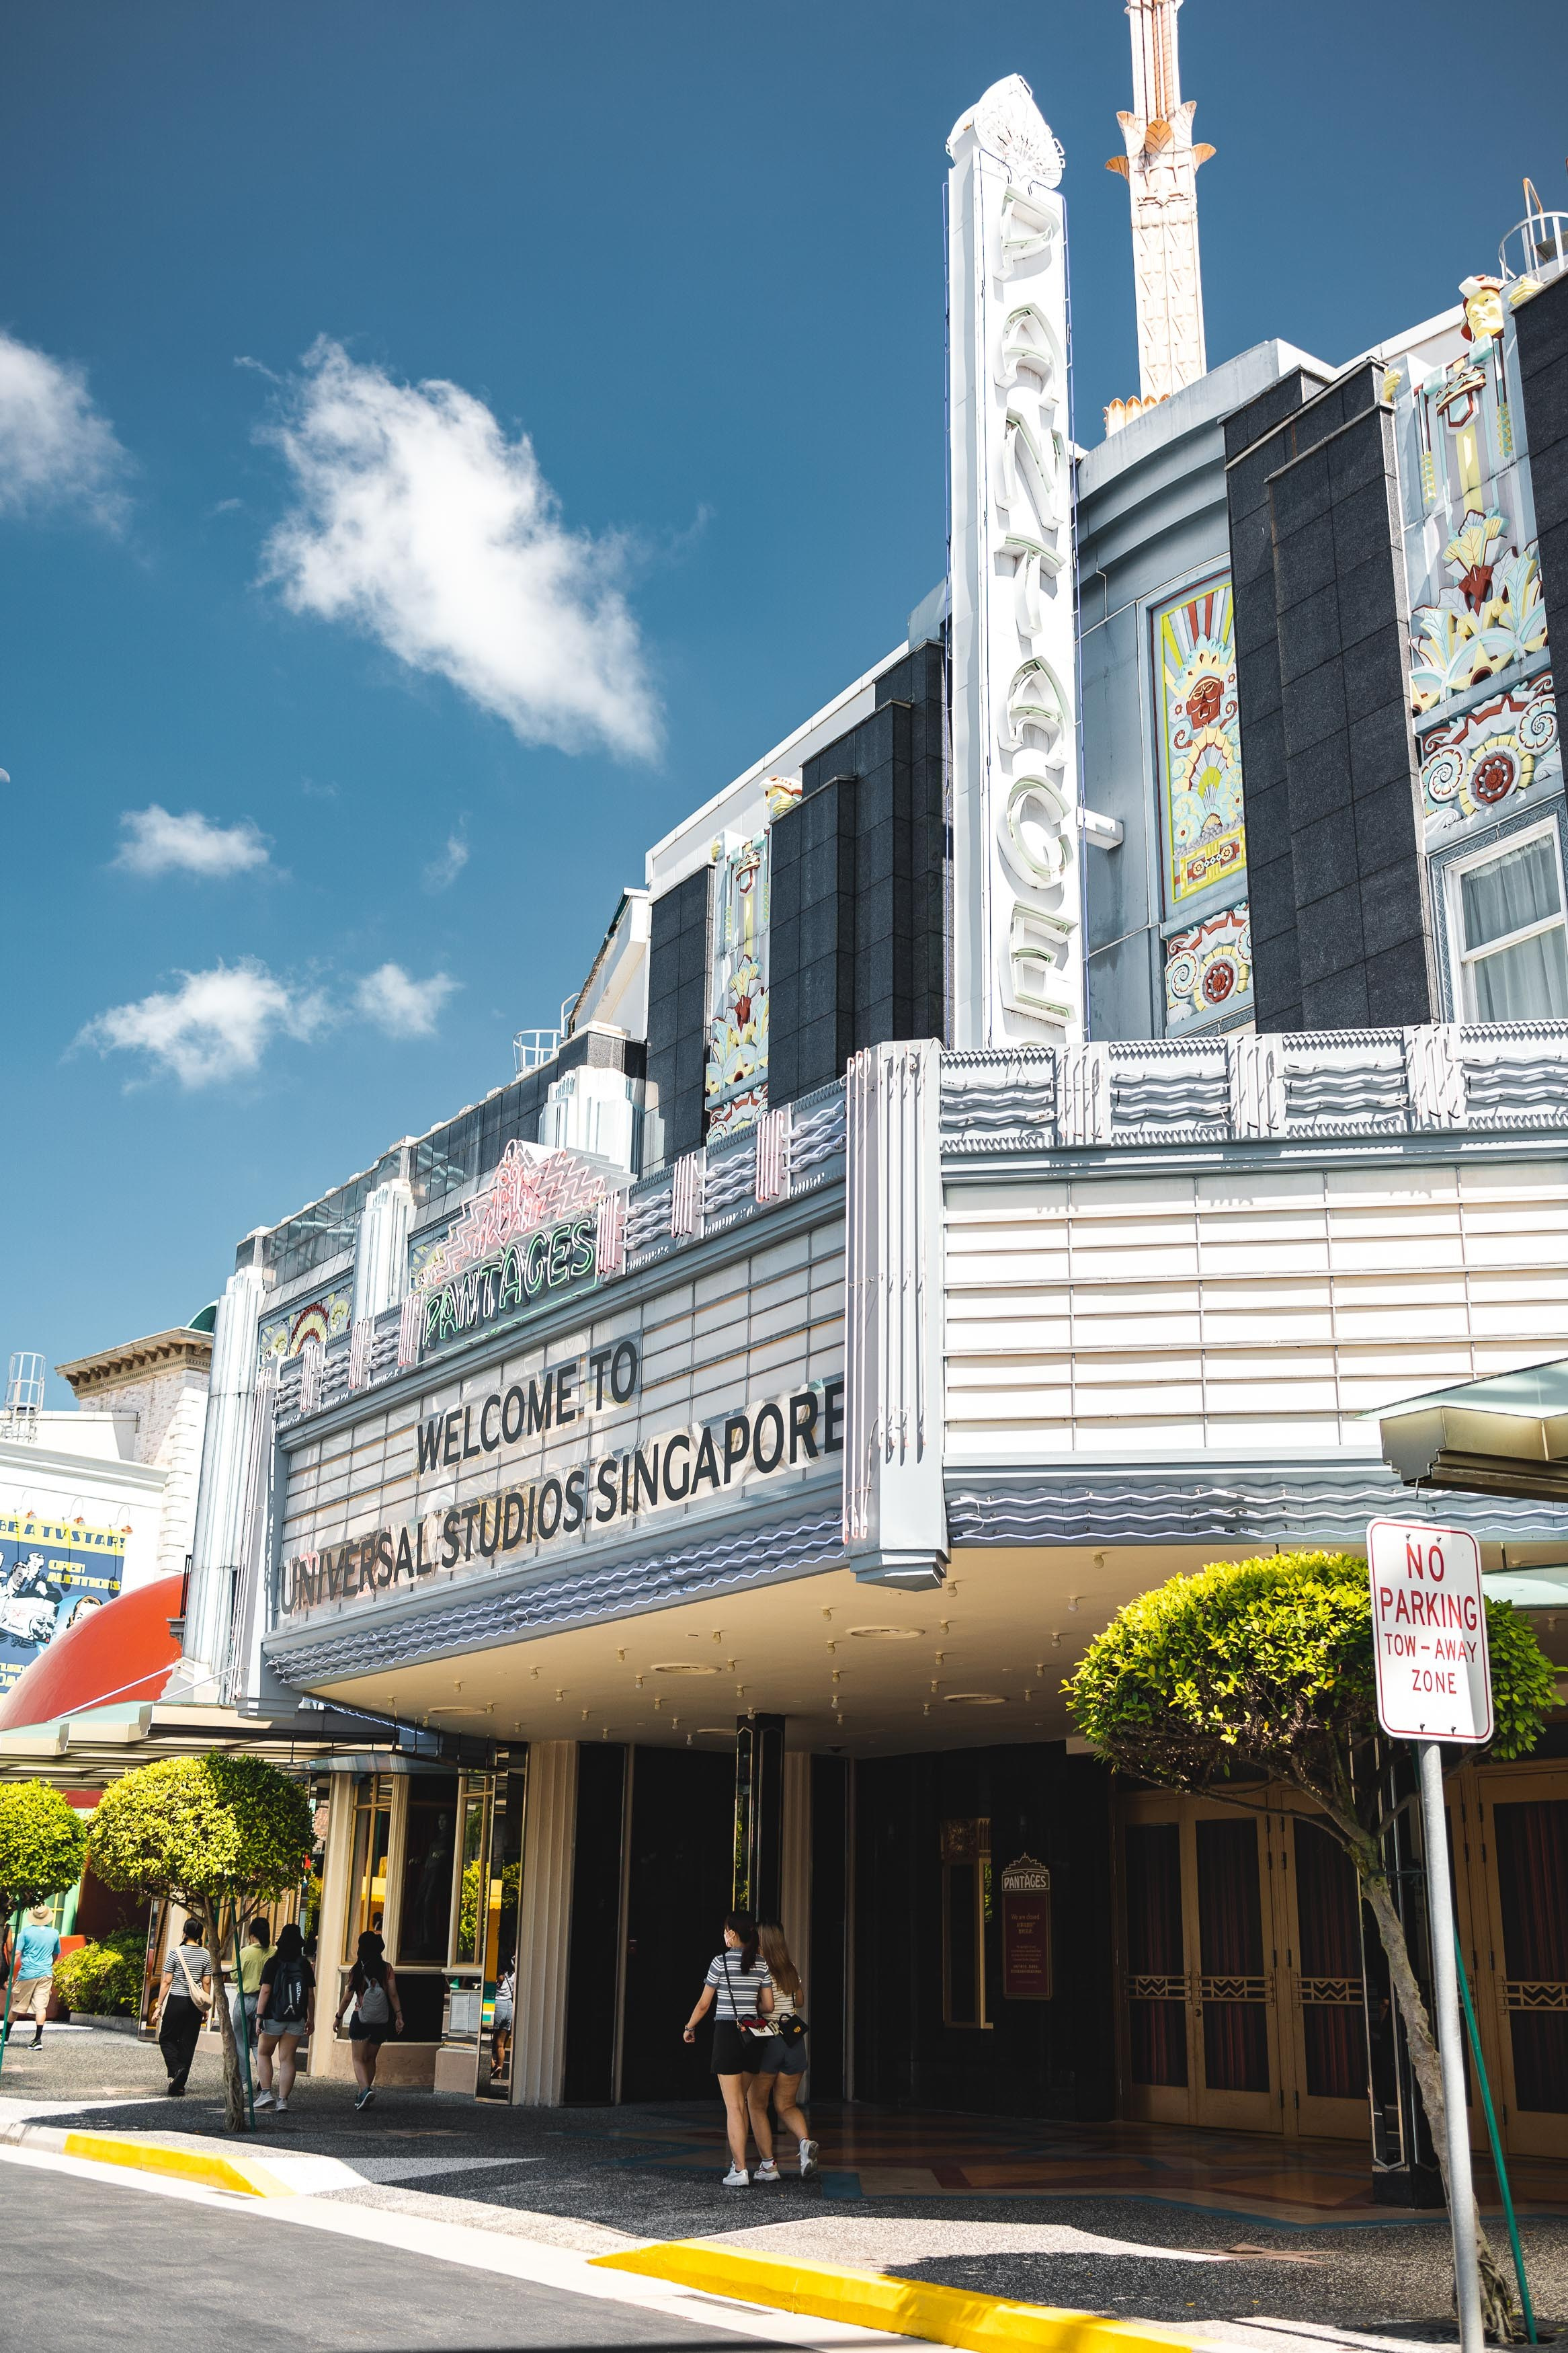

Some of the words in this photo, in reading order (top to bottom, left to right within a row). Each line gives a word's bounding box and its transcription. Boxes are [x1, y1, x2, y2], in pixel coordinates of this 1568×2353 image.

[993, 184, 1077, 1047] PANTAGE
[423, 1217, 597, 1349] PANTAGES
[417, 1363, 577, 1476] WELCOME
[589, 1341, 638, 1411] TO
[280, 1526, 432, 1616] UNIVERSAL
[442, 1471, 585, 1569] STUDIOS
[595, 1381, 845, 1524] SINGAPORE
[24, 1523, 35, 1536] A
[46, 1572, 121, 1591] AUDITIONS
[48, 1559, 86, 1574] OPEN
[1406, 1543, 1444, 1582] NO
[1380, 1587, 1477, 1631] PARKING
[1411, 1669, 1456, 1694] ZONE
[1004, 1874, 1046, 1889] PANTAGES
